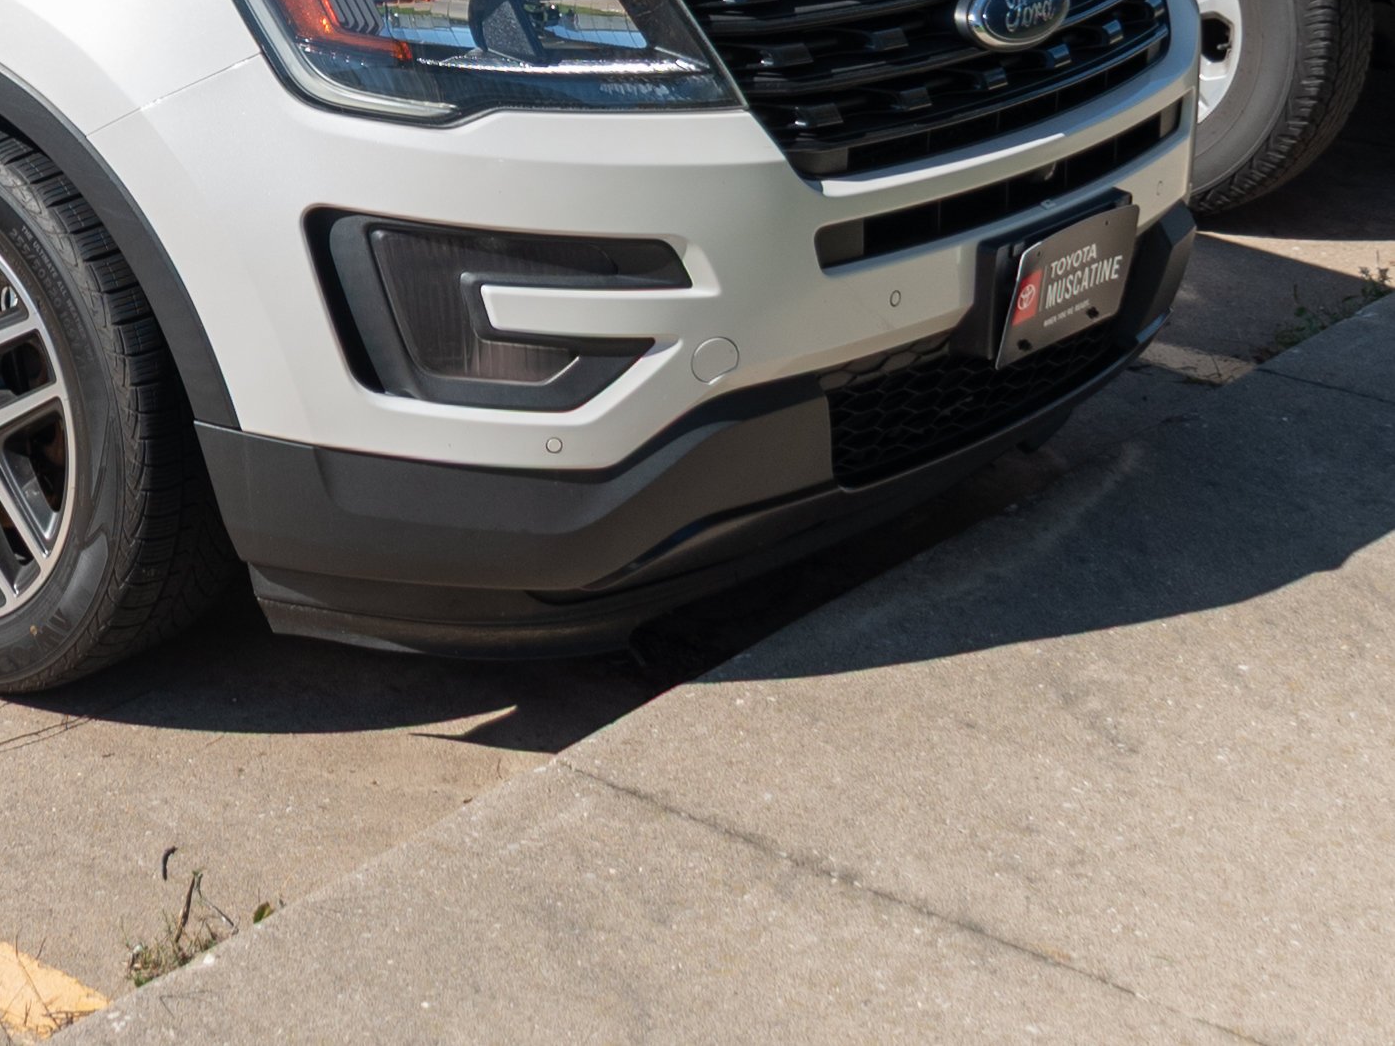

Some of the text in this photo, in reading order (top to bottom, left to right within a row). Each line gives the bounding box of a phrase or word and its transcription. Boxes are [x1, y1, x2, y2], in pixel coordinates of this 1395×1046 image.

[9, 228, 62, 308] 255/50R20
[21, 225, 33, 240] THE
[33, 241, 57, 278] ULTIMATE
[57, 280, 67, 297] ALL
[1045, 255, 1123, 309] MUSCATINE
[1051, 243, 1097, 278] TOYOTA
